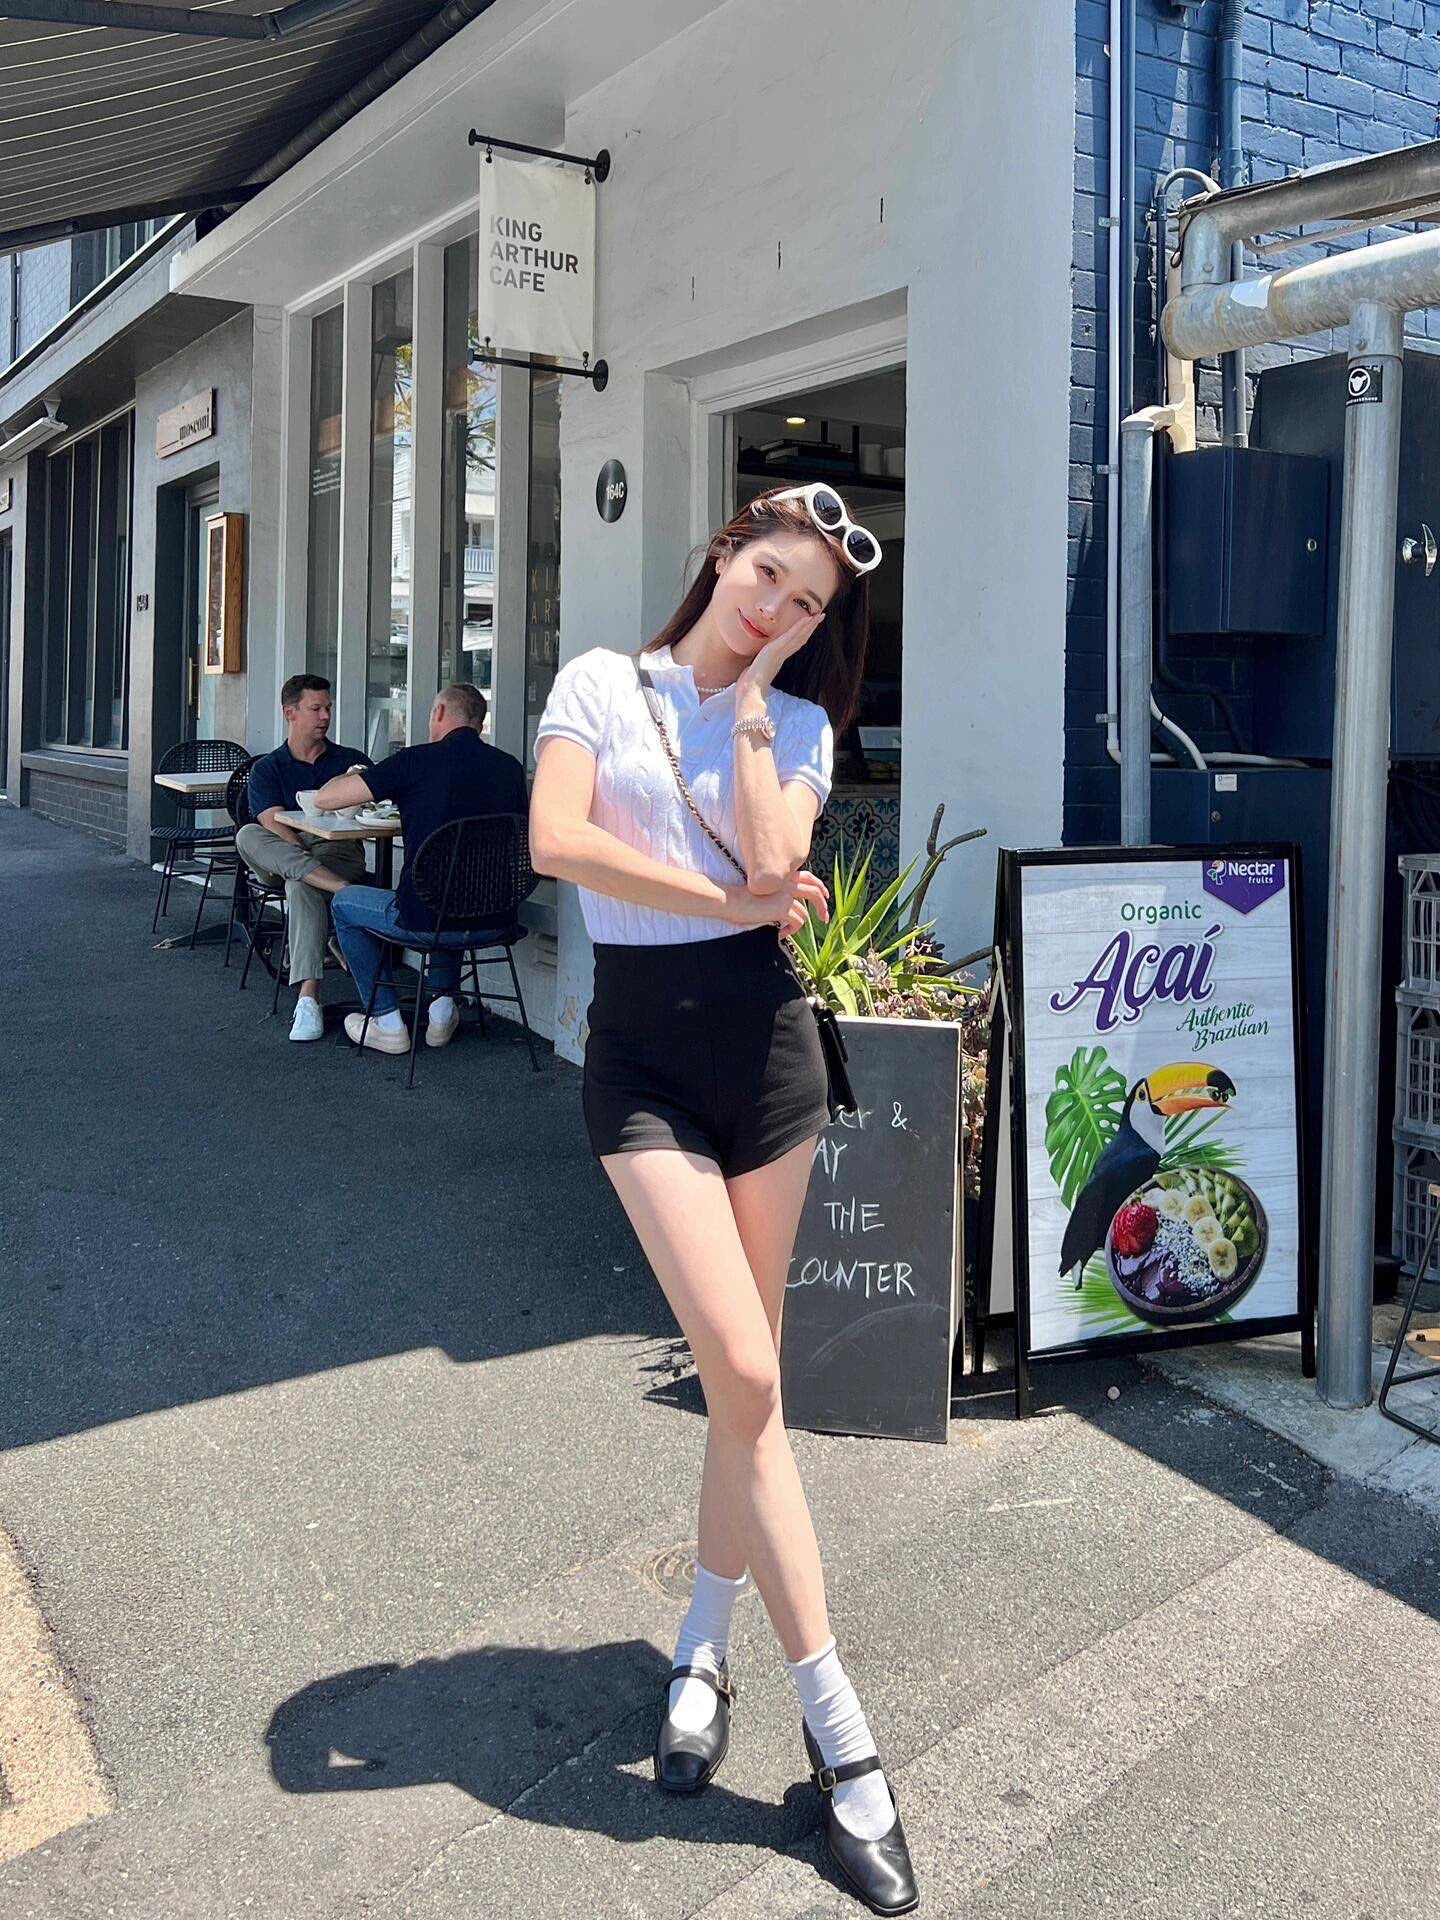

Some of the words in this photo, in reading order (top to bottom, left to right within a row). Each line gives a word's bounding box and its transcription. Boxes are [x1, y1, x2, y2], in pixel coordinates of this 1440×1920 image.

[489, 215, 542, 242] KING
[489, 241, 579, 274] ARTHUR
[489, 267, 545, 292] CAFE
[606, 482, 625, 501] 164C
[1228, 862, 1276, 876] Nectar
[1248, 876, 1274, 884] fruits
[1120, 901, 1202, 924] Organic
[1049, 923, 1222, 1032] Açaí
[1176, 1002, 1255, 1031] Authentic
[1192, 1019, 1270, 1052] Brazilian
[891, 1101, 908, 1131] &
[814, 1137, 848, 1182] AY
[823, 1196, 885, 1234] THE
